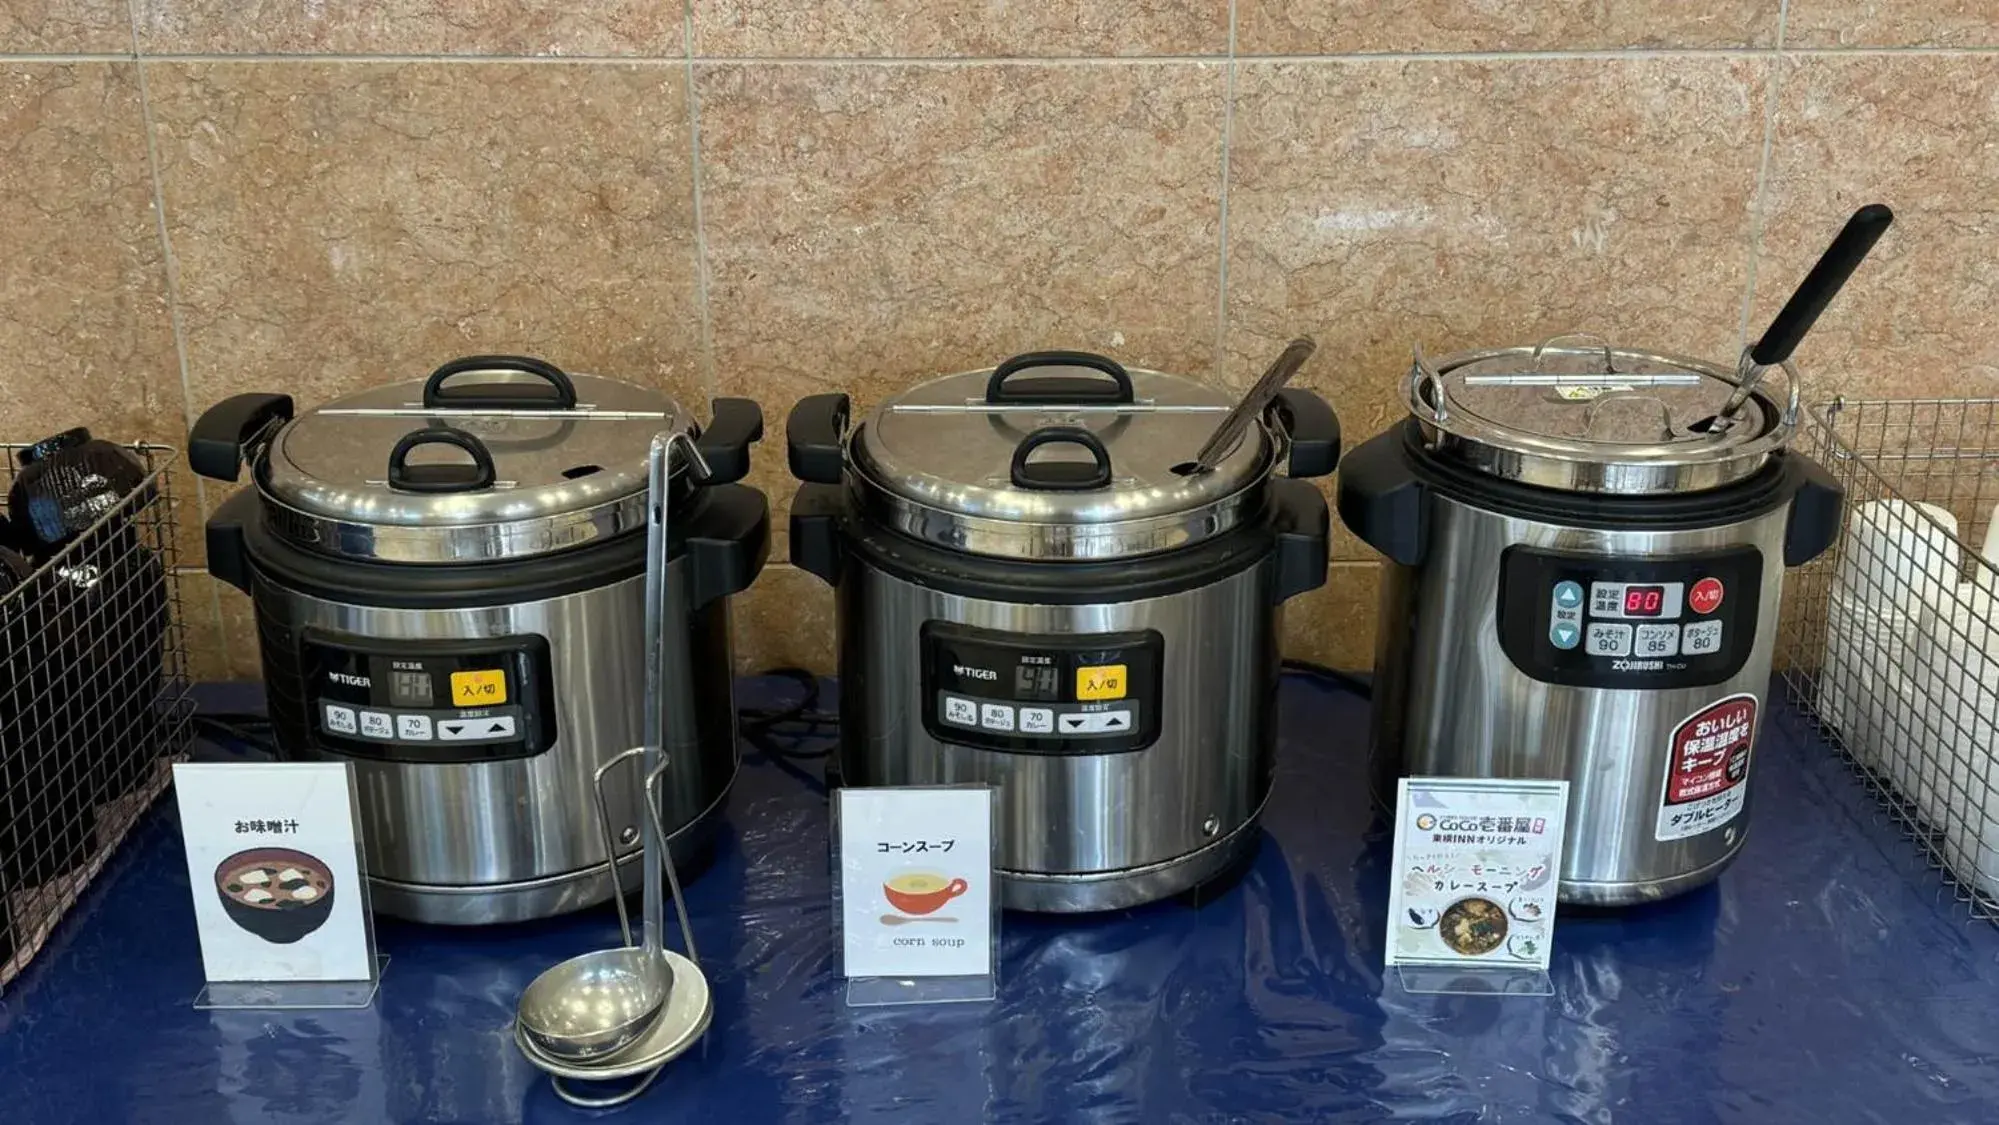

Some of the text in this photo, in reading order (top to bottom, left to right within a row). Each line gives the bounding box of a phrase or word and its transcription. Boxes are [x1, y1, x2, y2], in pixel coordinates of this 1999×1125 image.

[1596, 588, 1620, 599] 設定
[1626, 591, 1659, 611] 80
[1556, 610, 1576, 620] 設定
[1593, 628, 1625, 640] みそ汁
[1641, 629, 1675, 640] コンソメ
[1598, 639, 1618, 651] 90
[1647, 640, 1666, 652] 85
[1693, 637, 1711, 650] 80
[1612, 659, 1664, 672] ZOJIRUSHI
[965, 667, 997, 681] TIGER
[339, 673, 371, 688] TIGER
[954, 702, 967, 712] 90
[333, 710, 346, 720] 90
[991, 709, 1004, 718] 80
[1030, 712, 1043, 721] 70
[369, 716, 382, 726] 80
[408, 719, 420, 728] 70
[1696, 708, 1747, 737] おいしい
[1681, 748, 1727, 772] キープ
[1671, 796, 1739, 827] ダブルヒーター
[234, 819, 299, 834] お味噌汁
[1440, 816, 1531, 833] CoCo壱番屋
[877, 839, 955, 853] コーンスープ
[1434, 881, 1519, 893] カレースープ
[893, 938, 965, 948] corn soup
